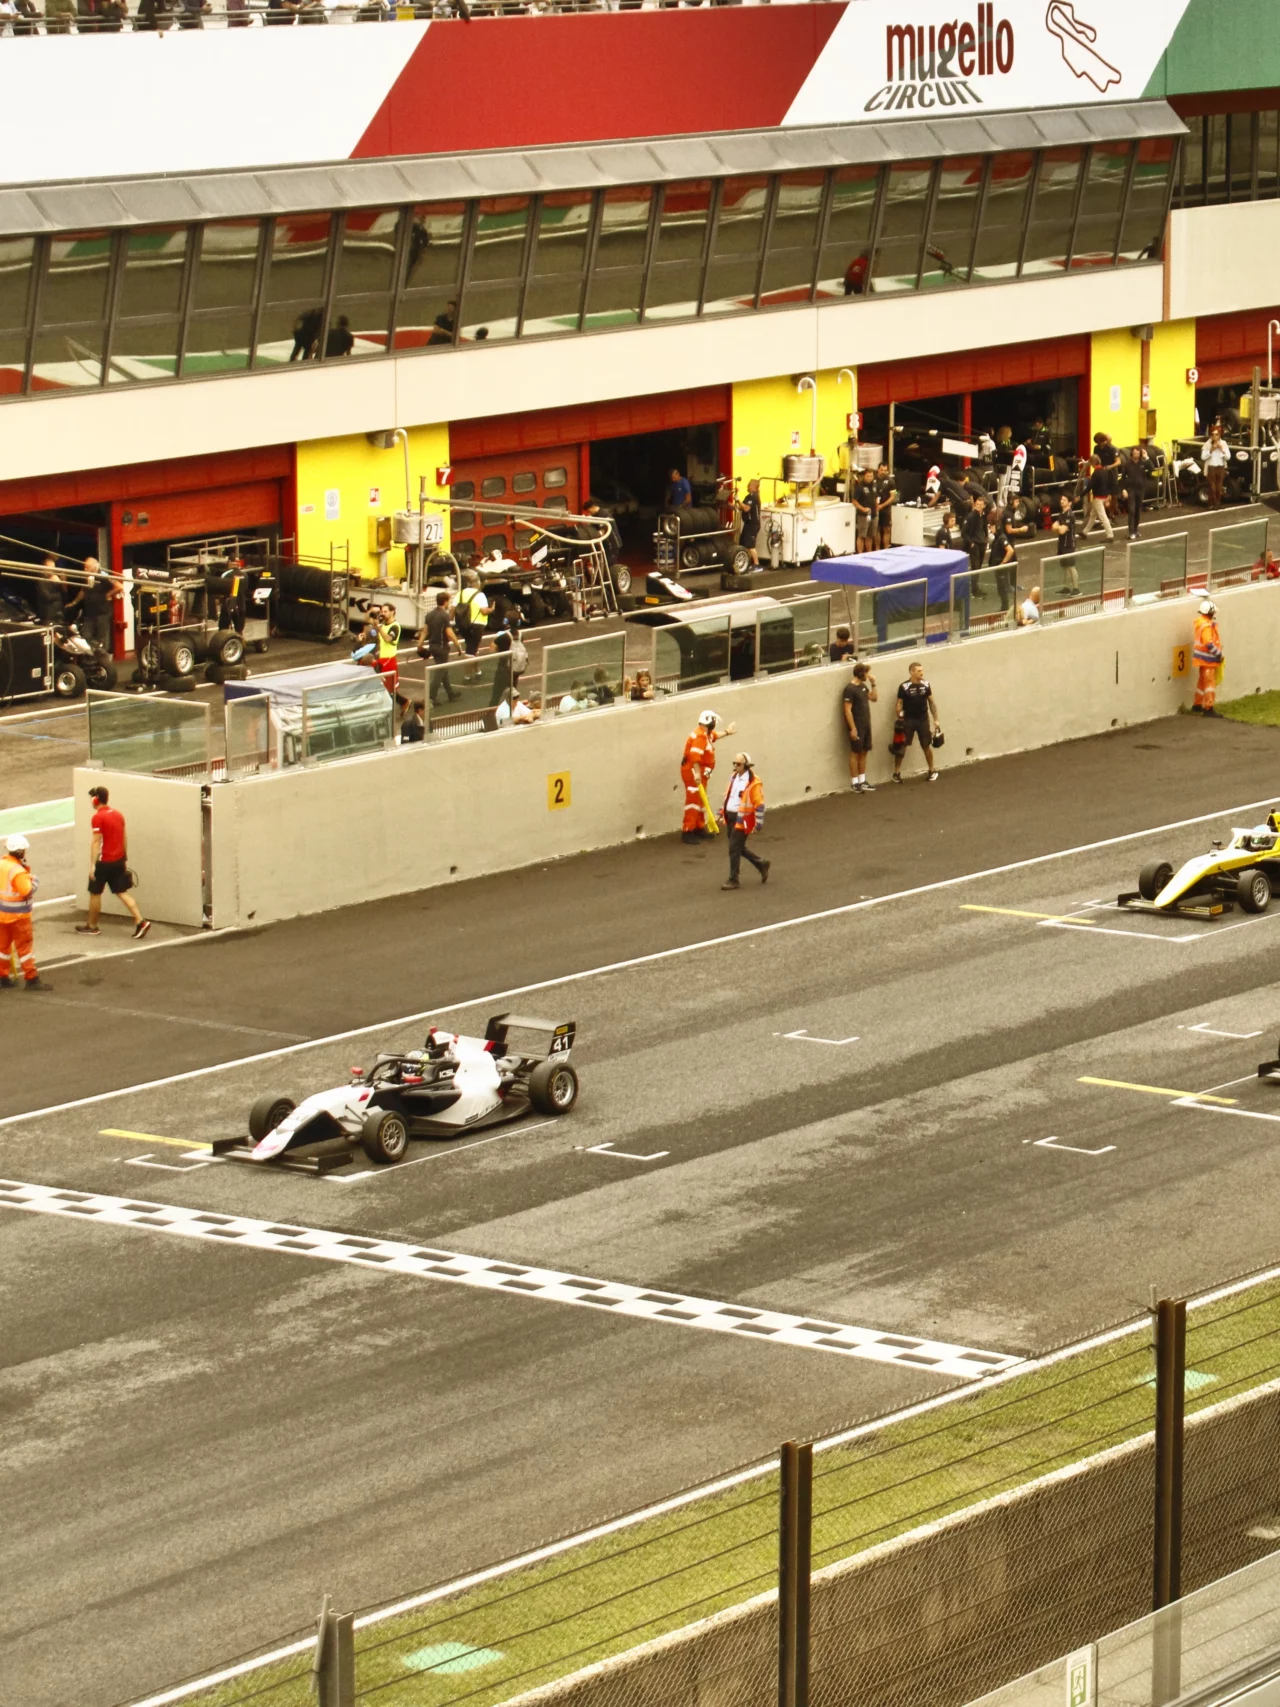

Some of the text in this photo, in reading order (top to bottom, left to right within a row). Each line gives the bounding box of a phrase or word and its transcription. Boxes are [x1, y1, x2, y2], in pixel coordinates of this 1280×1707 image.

[886, 2, 1014, 82] mugello
[863, 80, 983, 112] CIRCUIT
[1188, 368, 1199, 383] 9
[849, 413, 860, 429] 8
[439, 468, 451, 485] 7
[1178, 650, 1185, 672] 3
[554, 778, 564, 804] 2
[553, 1036, 568, 1051] 41
